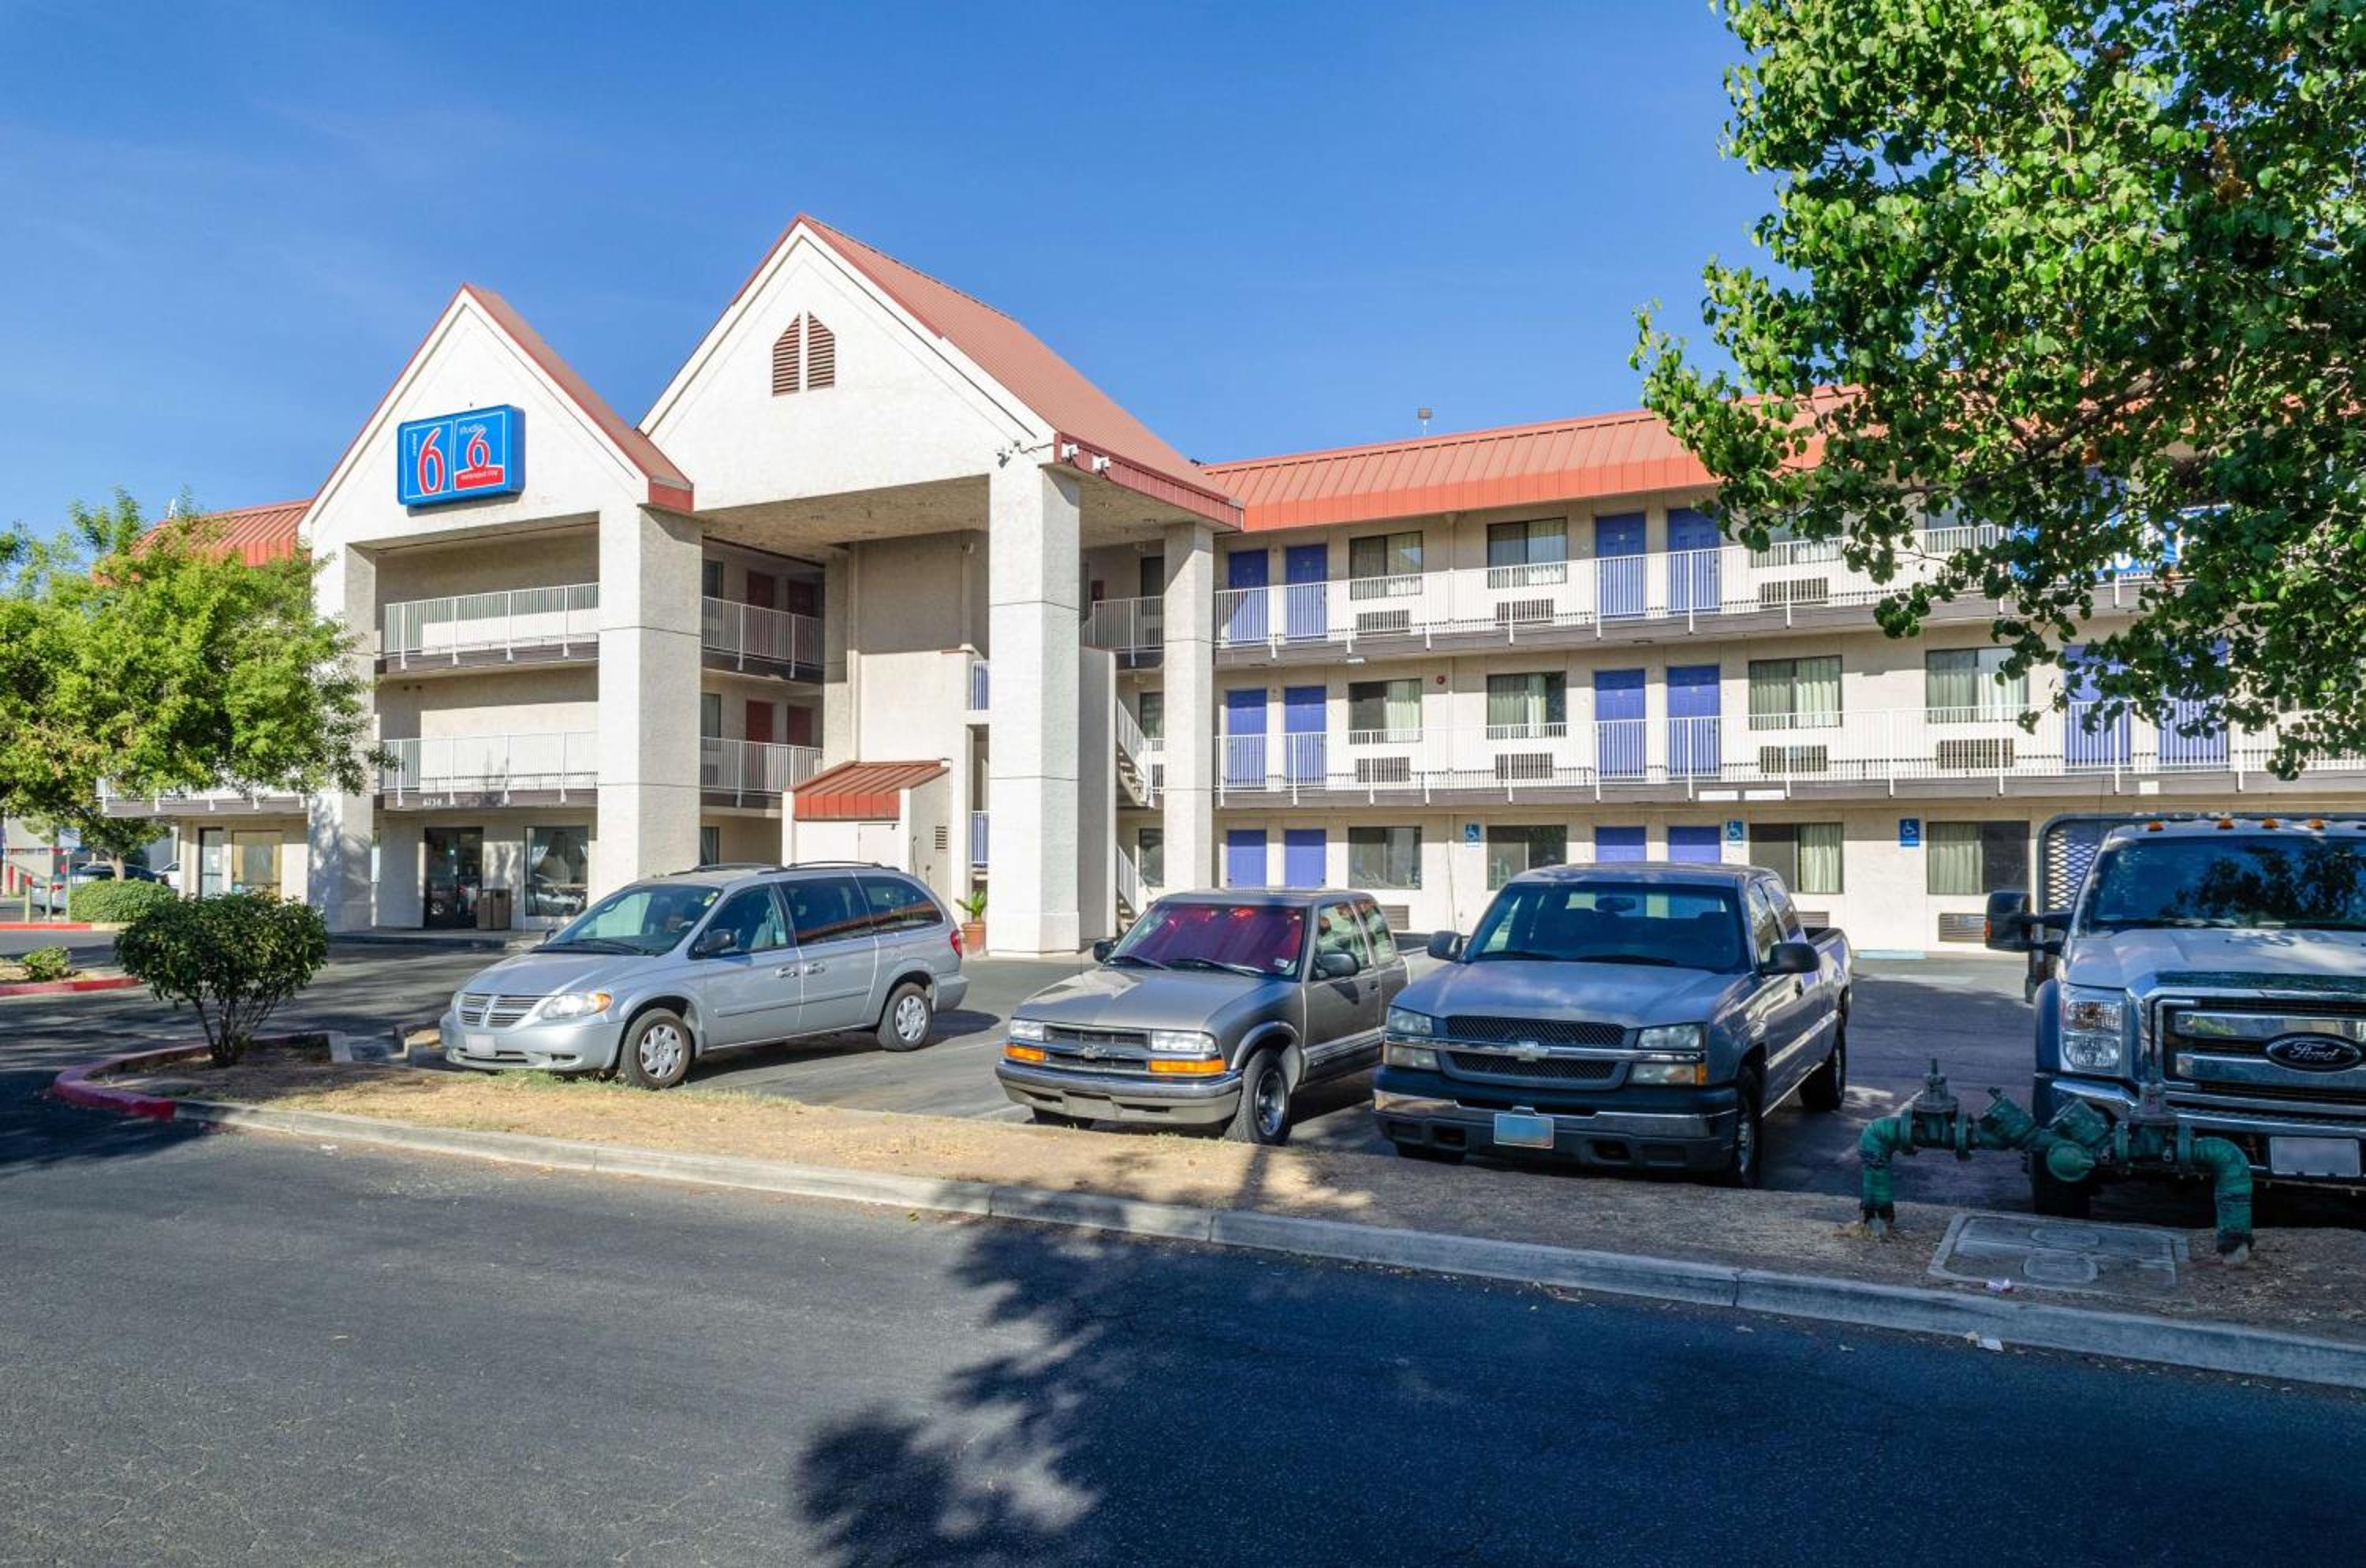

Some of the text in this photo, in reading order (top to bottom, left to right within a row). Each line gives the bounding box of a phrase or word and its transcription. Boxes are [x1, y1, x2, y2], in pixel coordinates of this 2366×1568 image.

[418, 427, 445, 495] 6
[466, 428, 491, 469] 6
[2288, 1042, 2341, 1061] Ford
